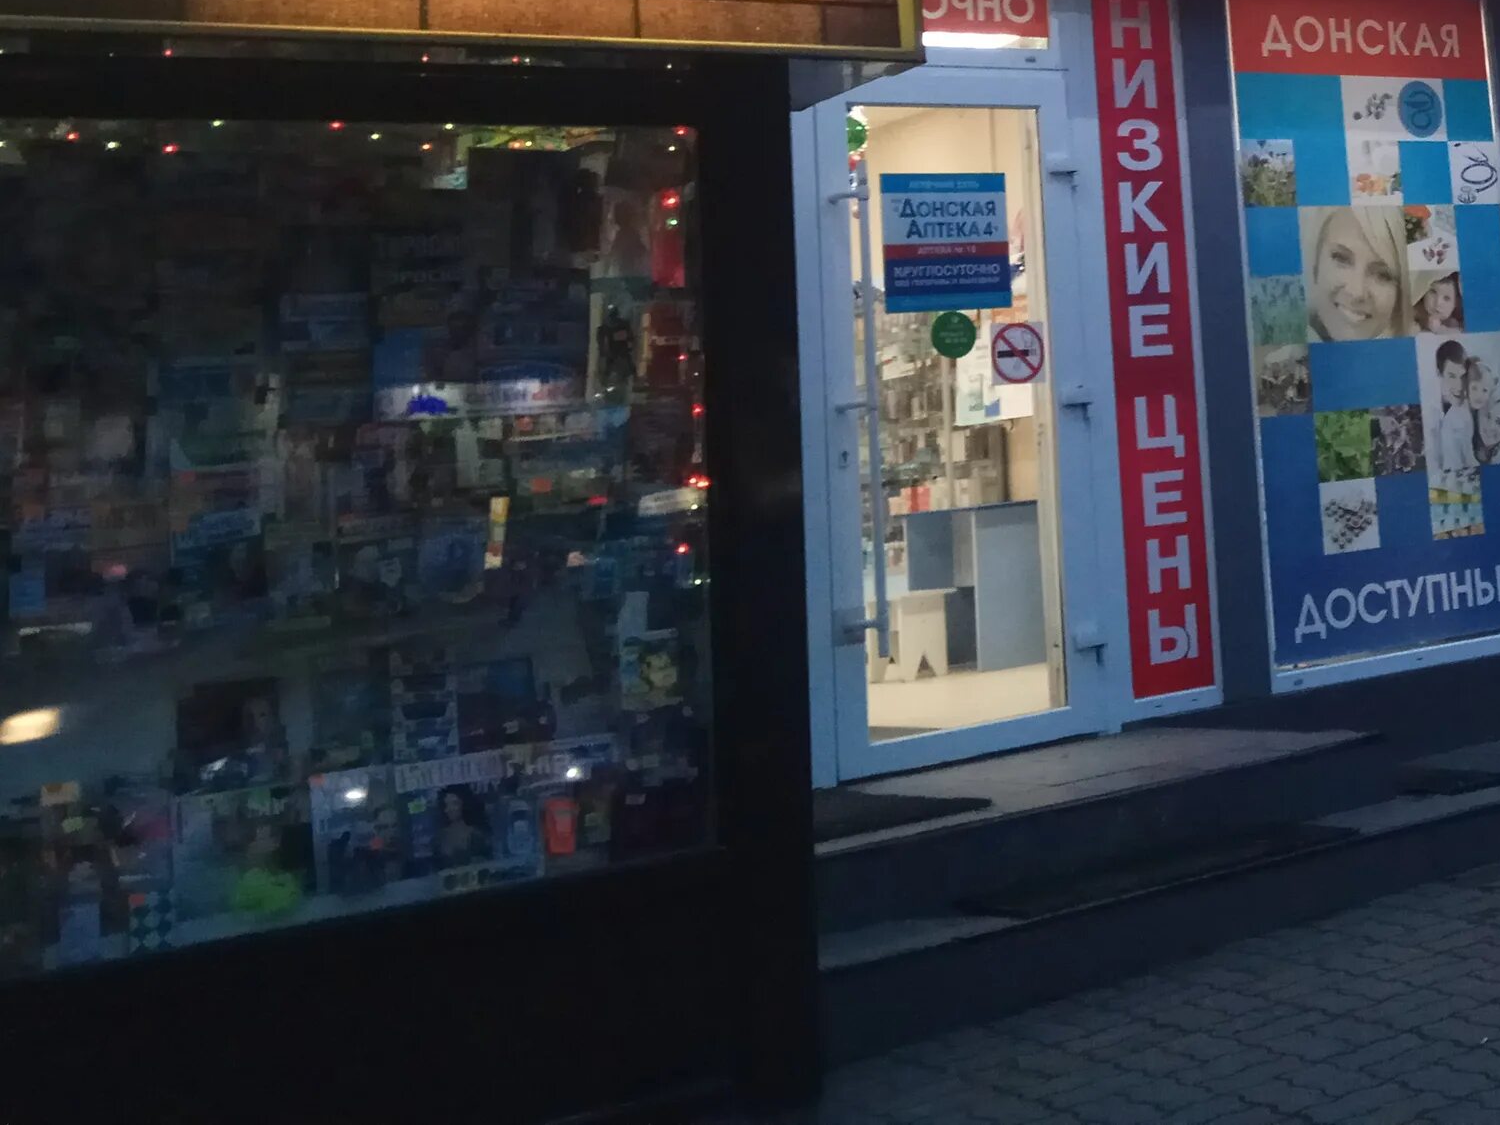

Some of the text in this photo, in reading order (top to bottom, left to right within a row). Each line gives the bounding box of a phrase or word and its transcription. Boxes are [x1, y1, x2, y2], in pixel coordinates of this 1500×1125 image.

[1261, 14, 1461, 59] ДОНСКАЯ
[899, 198, 997, 218] ДОНСКАЯ
[906, 219, 981, 239] АПТЕКА
[893, 263, 1001, 278] КРУГЛОСУТОЧНО
[1133, 392, 1197, 666] ЦЕНЫ
